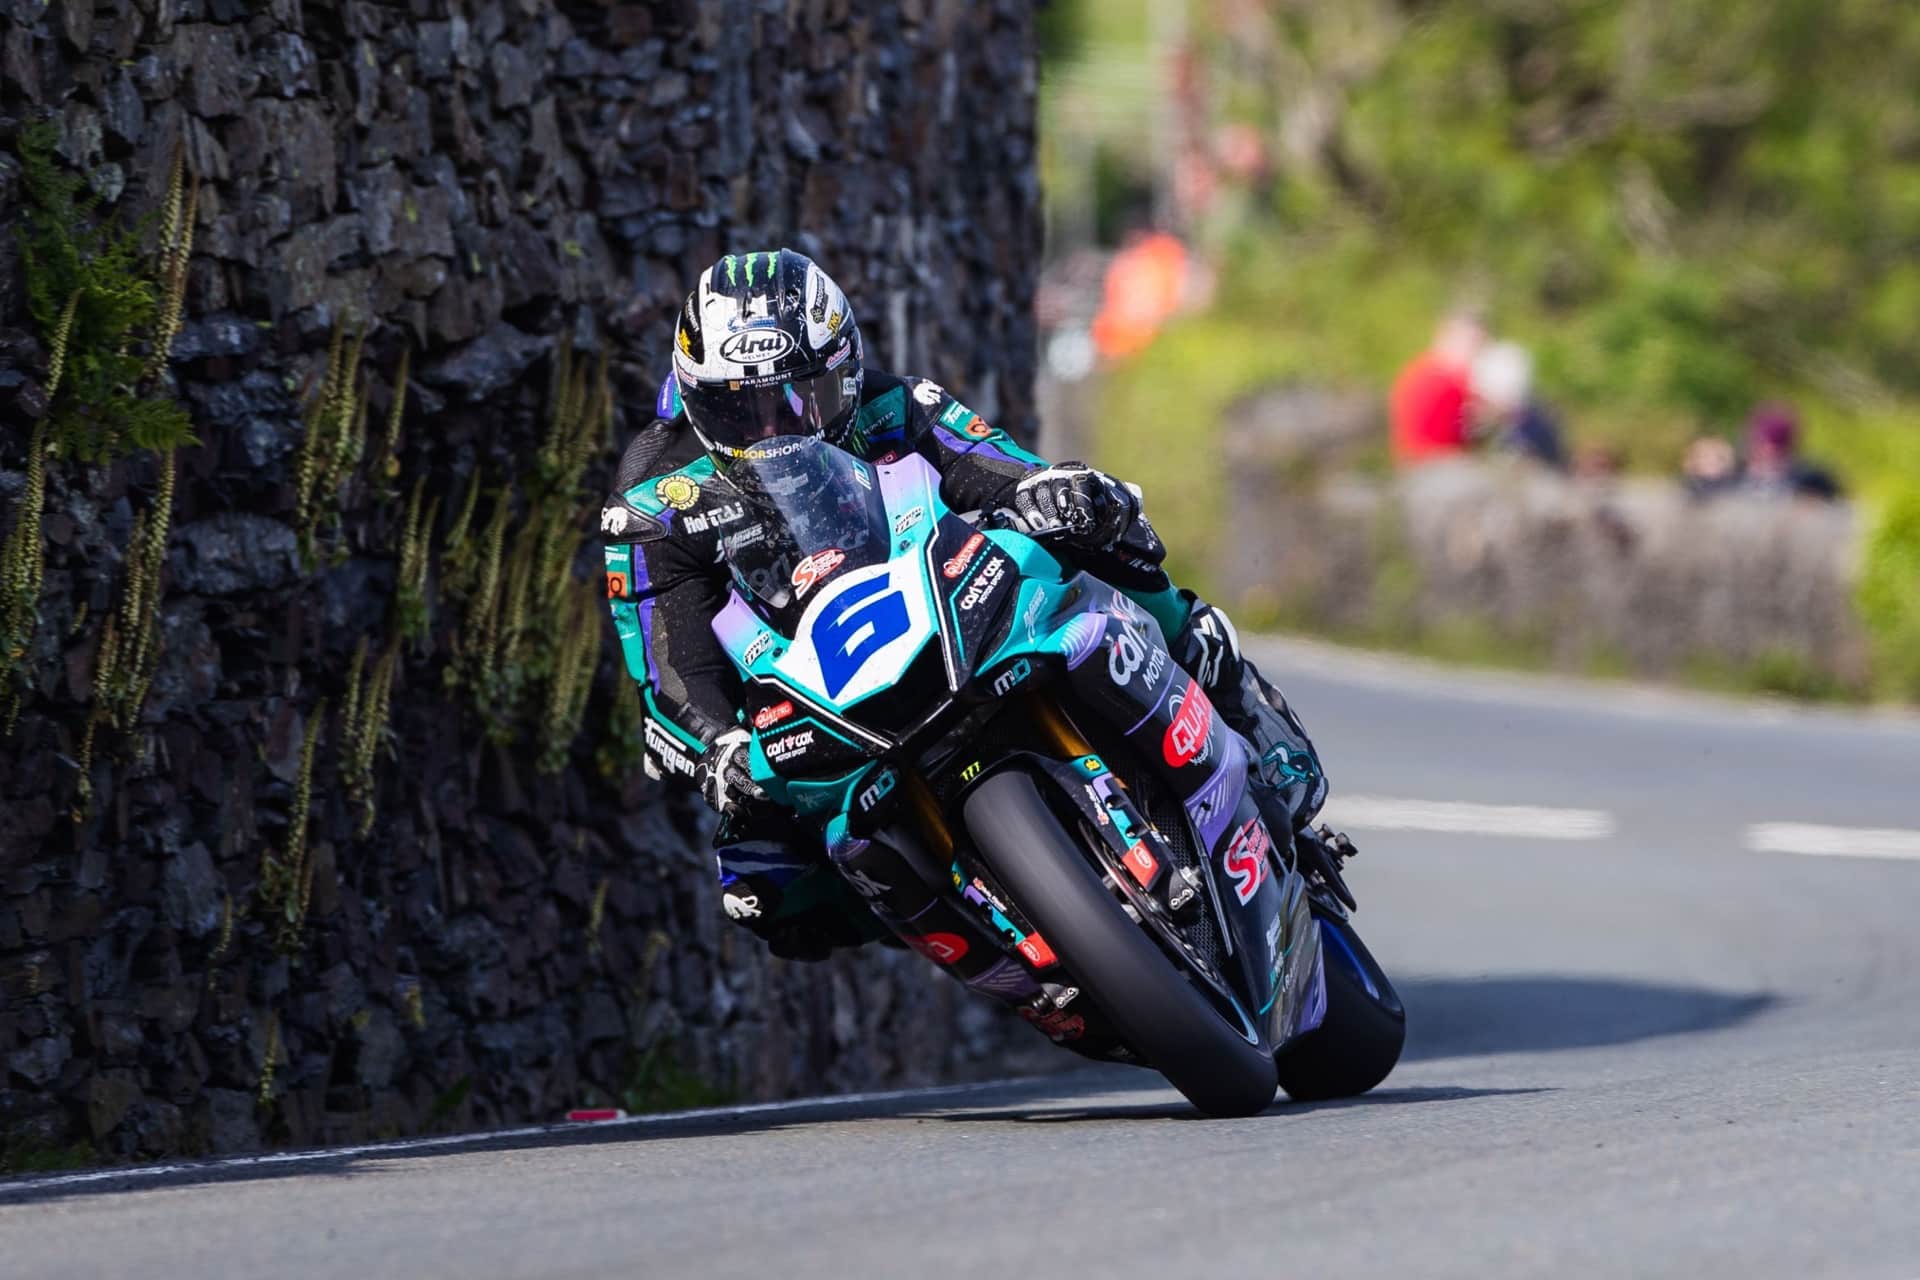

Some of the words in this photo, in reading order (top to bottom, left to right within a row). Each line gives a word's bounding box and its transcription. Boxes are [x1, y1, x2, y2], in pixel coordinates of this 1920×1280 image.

[725, 332, 783, 358] Arai
[740, 371, 793, 385] PARAMOUNT
[811, 572, 911, 700] 6
